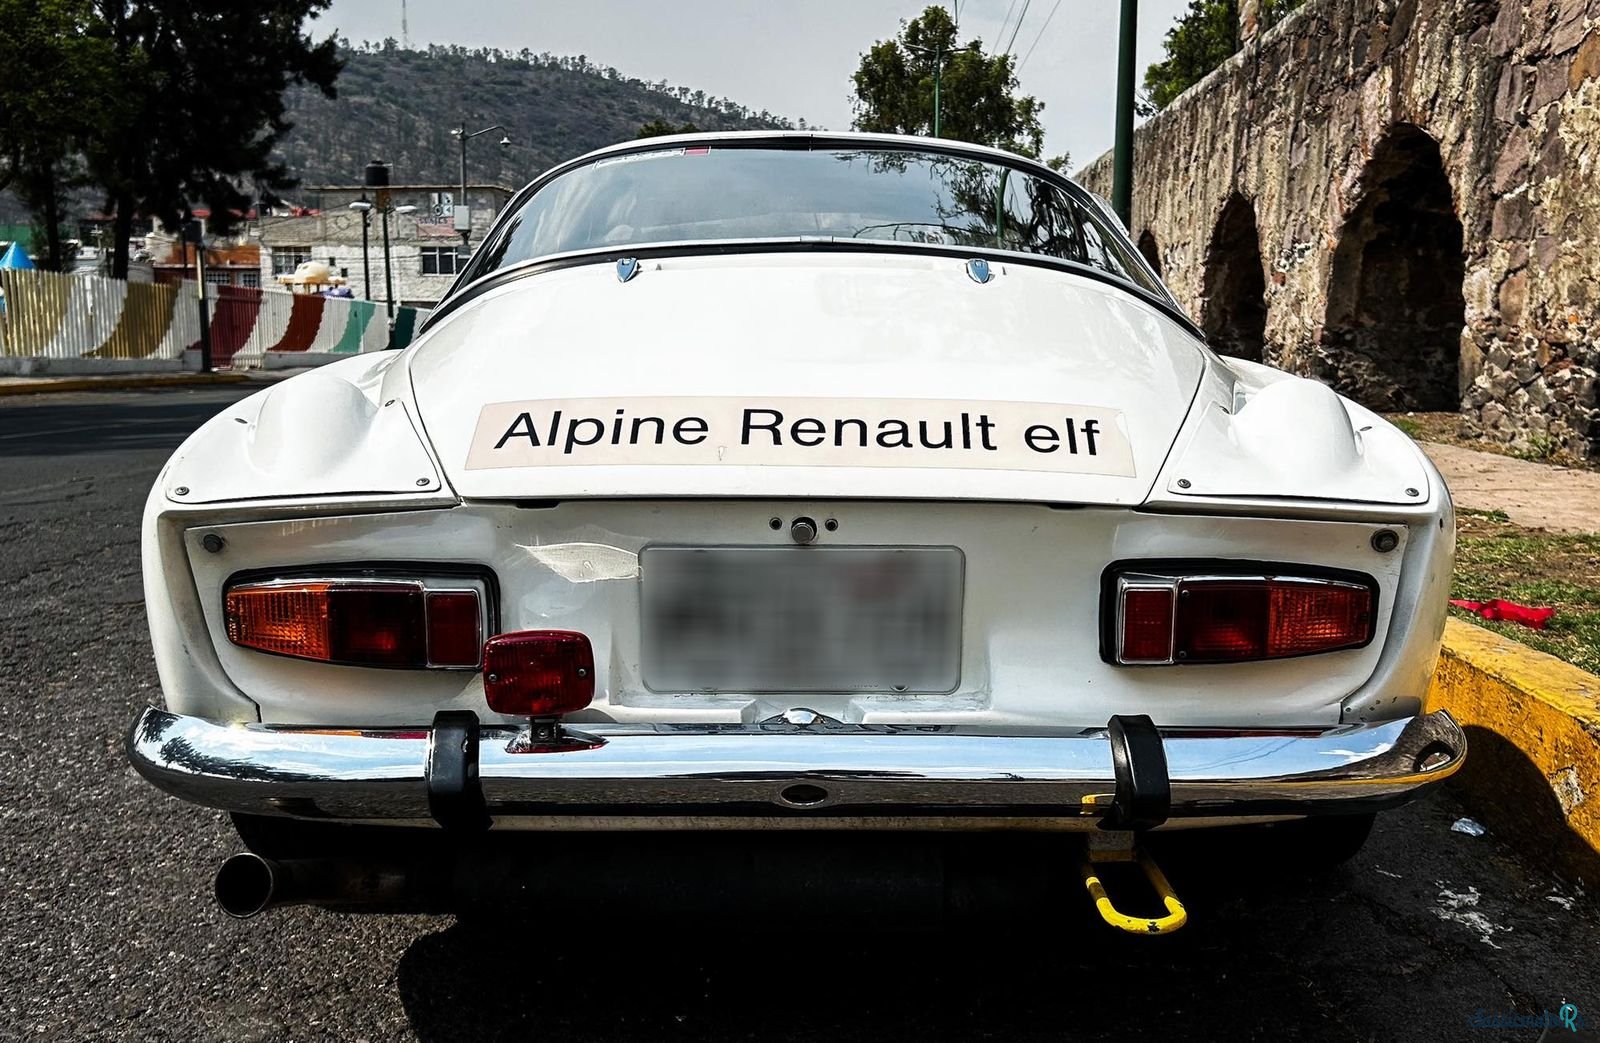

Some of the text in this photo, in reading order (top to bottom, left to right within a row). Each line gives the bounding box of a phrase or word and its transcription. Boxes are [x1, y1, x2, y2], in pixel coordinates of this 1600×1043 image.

[494, 408, 1100, 456] Alpine Renault elf
